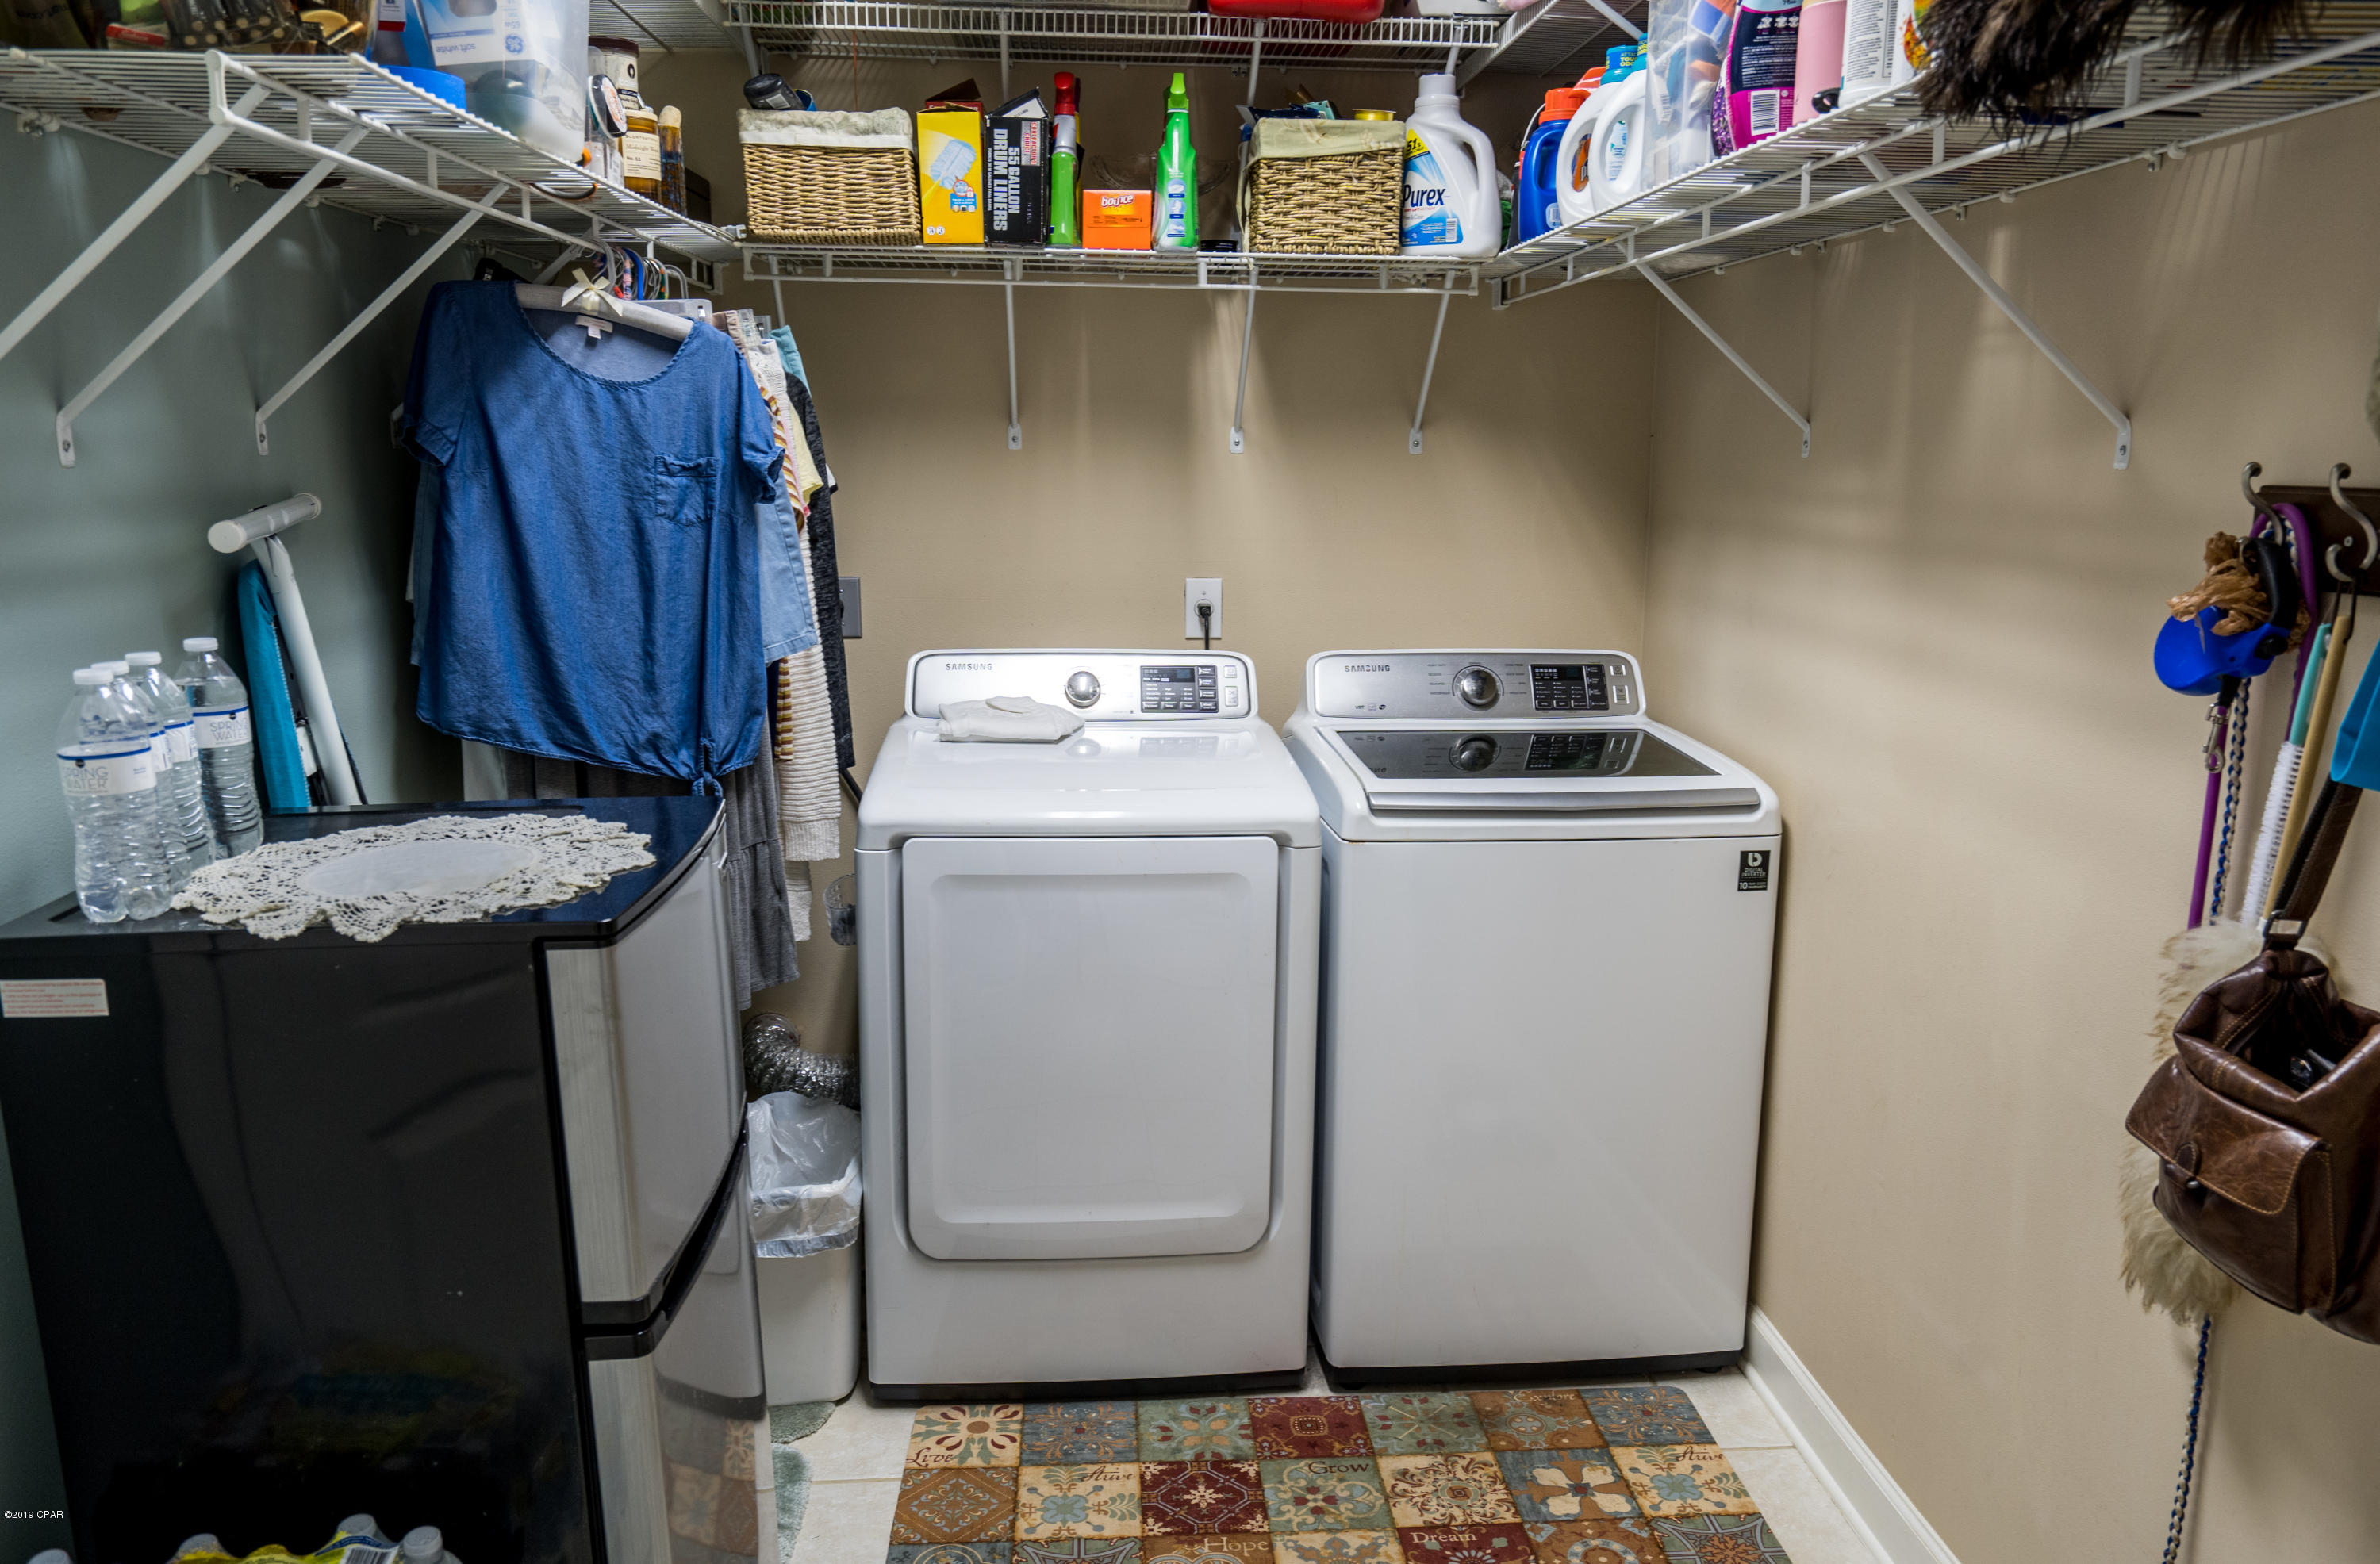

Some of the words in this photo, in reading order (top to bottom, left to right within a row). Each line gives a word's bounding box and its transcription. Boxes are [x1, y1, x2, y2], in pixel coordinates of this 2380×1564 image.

[993, 128, 1008, 175] DRUM
[1008, 147, 1020, 165] 55
[1008, 167, 1020, 214] GALLON
[1403, 184, 1445, 208] Purex
[993, 179, 1008, 231] LINERS
[1101, 195, 1134, 207] bounce
[906, 1447, 953, 1467] Live
[1308, 1461, 1369, 1474] Grow
[1204, 1536, 1269, 1557] Hope
[1411, 1532, 1477, 1543] Dream
